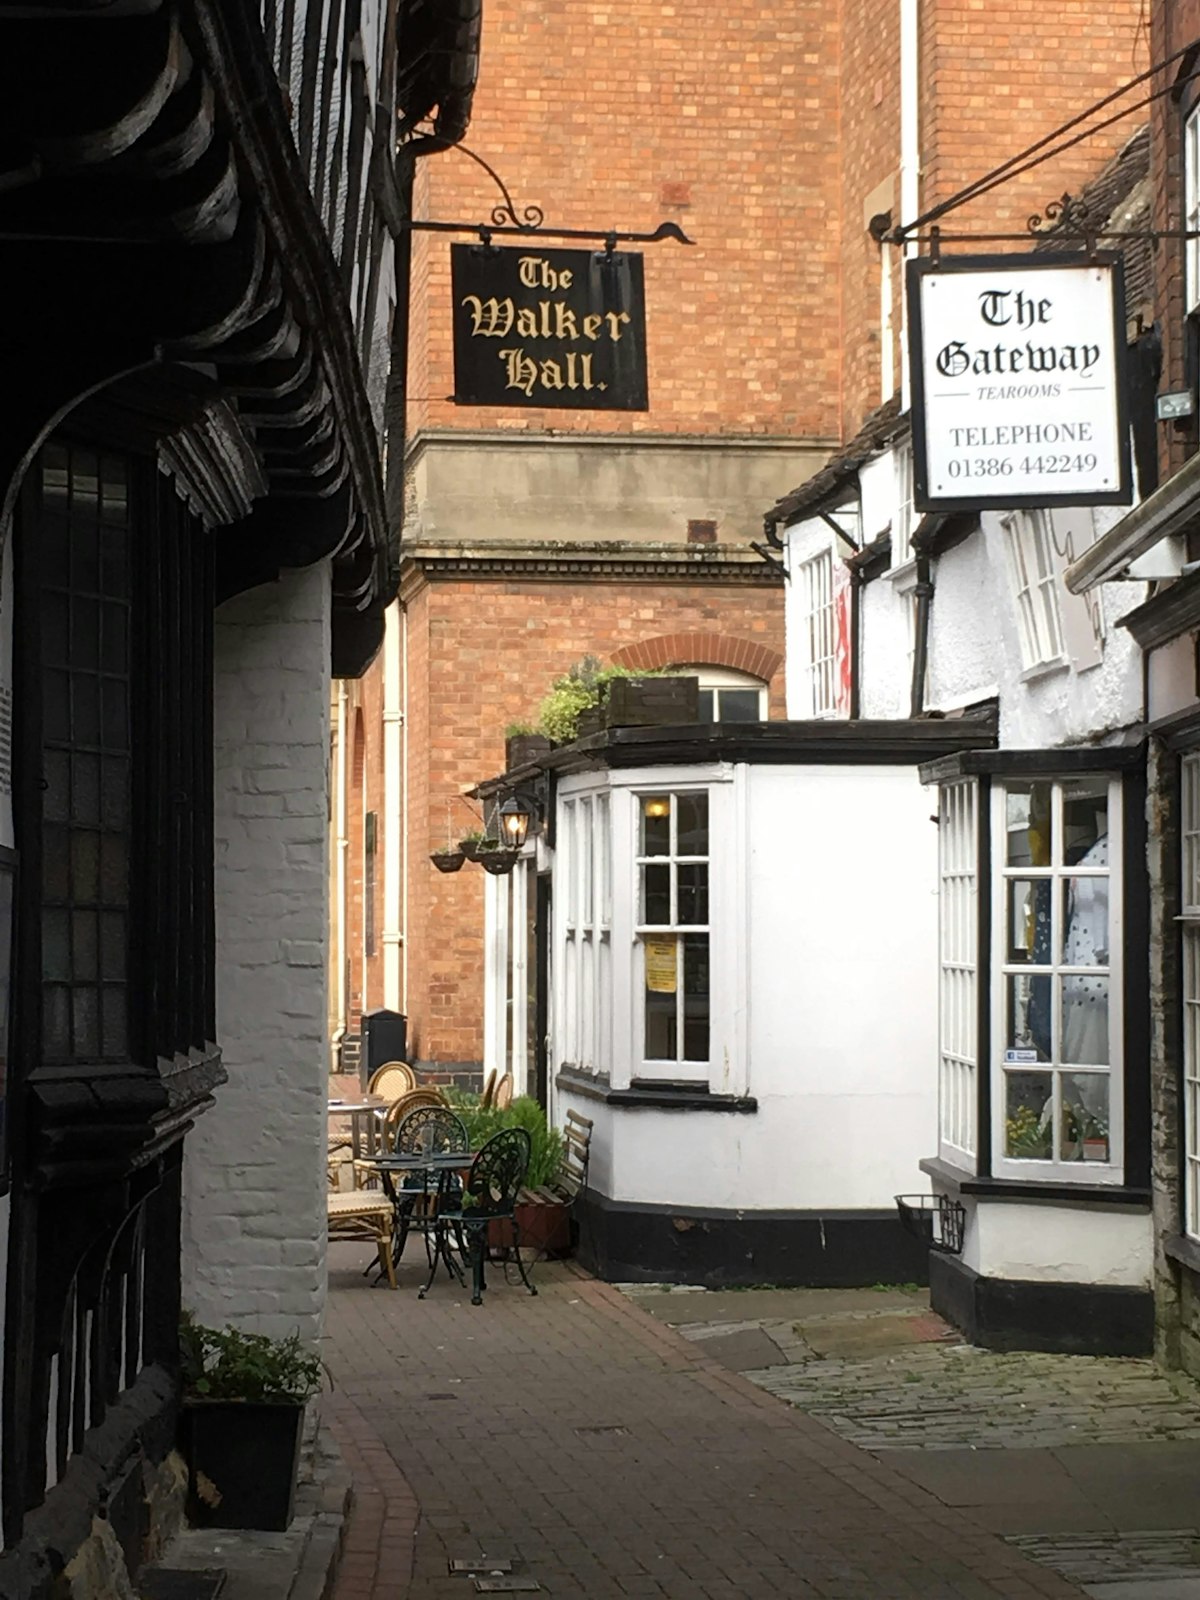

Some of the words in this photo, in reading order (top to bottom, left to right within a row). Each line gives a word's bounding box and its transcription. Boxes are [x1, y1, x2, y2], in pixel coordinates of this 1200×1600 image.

[518, 256, 573, 291] The
[462, 295, 631, 342] Walker
[978, 289, 1053, 331] The
[498, 348, 608, 397] Hall.
[936, 340, 1100, 378] Gateway
[977, 384, 1061, 400] TEAROOMS
[950, 422, 1093, 447] TELEPHONE
[948, 457, 1013, 478] 01386
[1019, 453, 1098, 475] 442249
